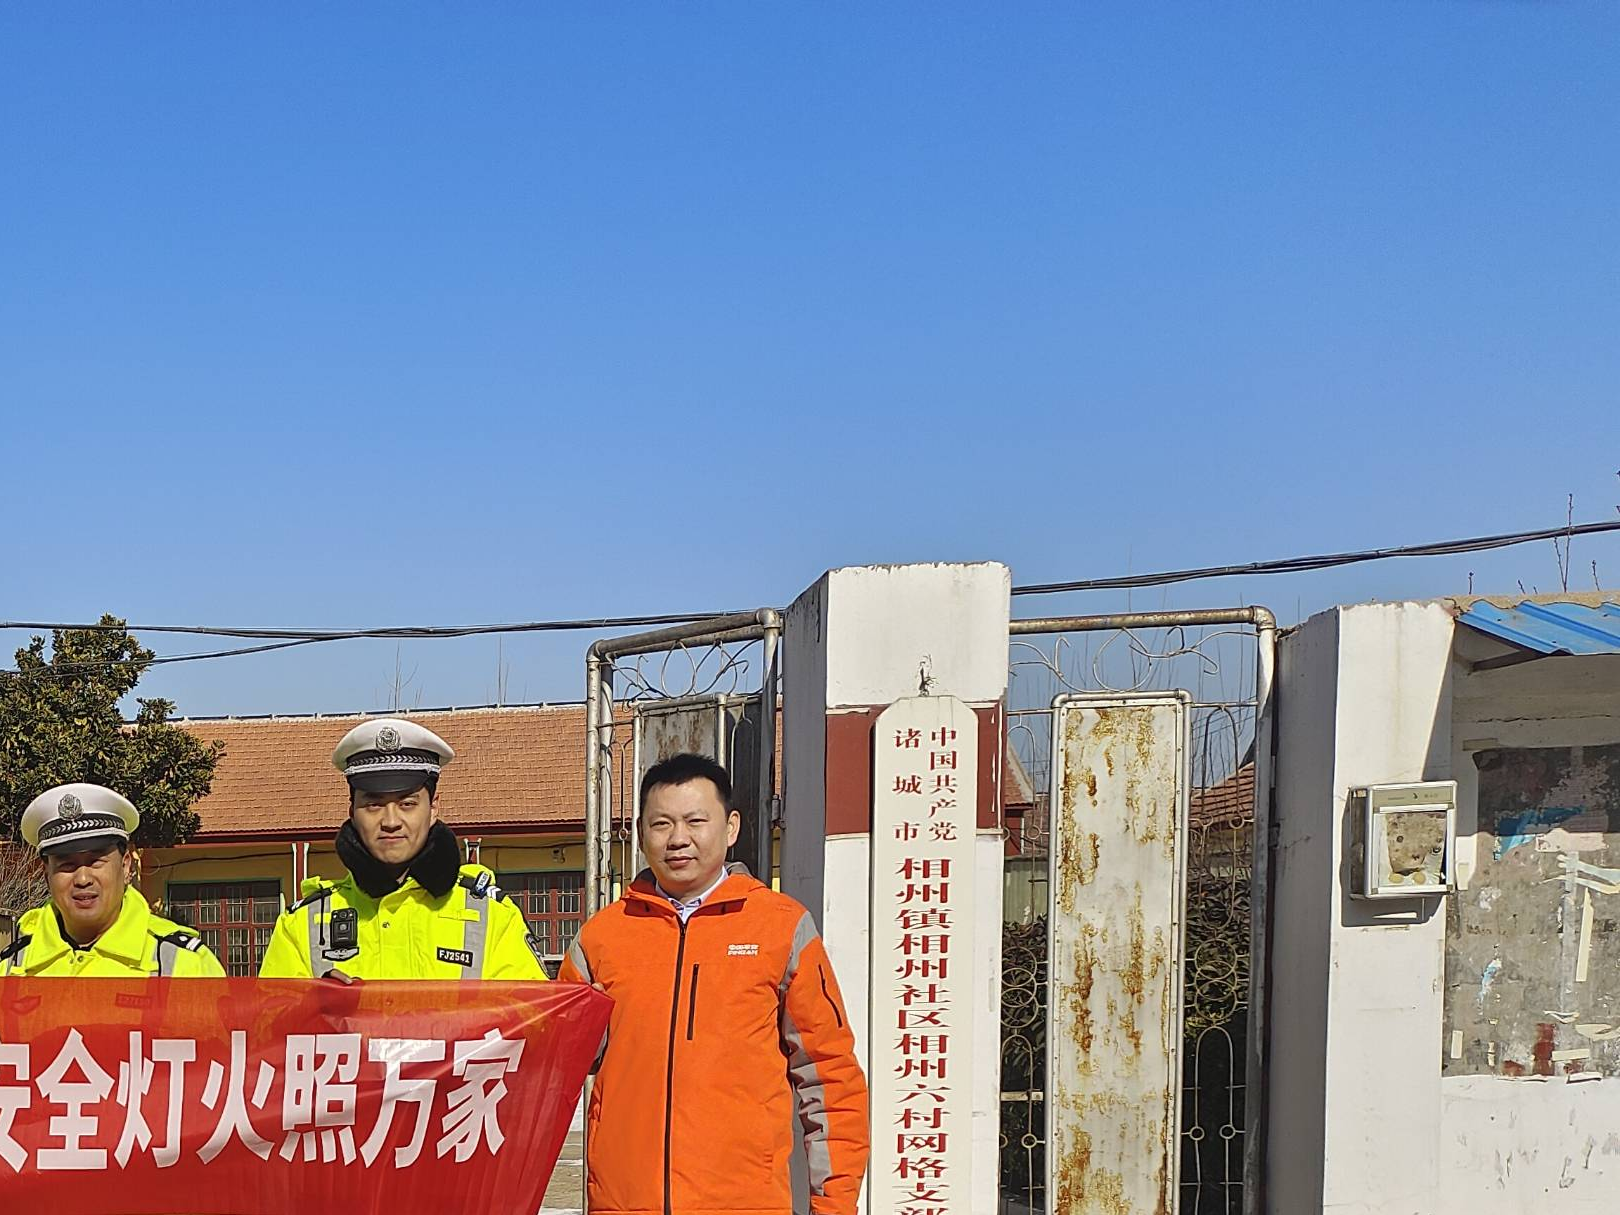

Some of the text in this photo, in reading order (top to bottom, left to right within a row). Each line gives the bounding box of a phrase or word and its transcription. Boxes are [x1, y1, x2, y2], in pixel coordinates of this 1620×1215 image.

[892, 727, 924, 842] 诸城市
[928, 726, 959, 842] 中国共产党
[438, 949, 471, 964] FJ2541
